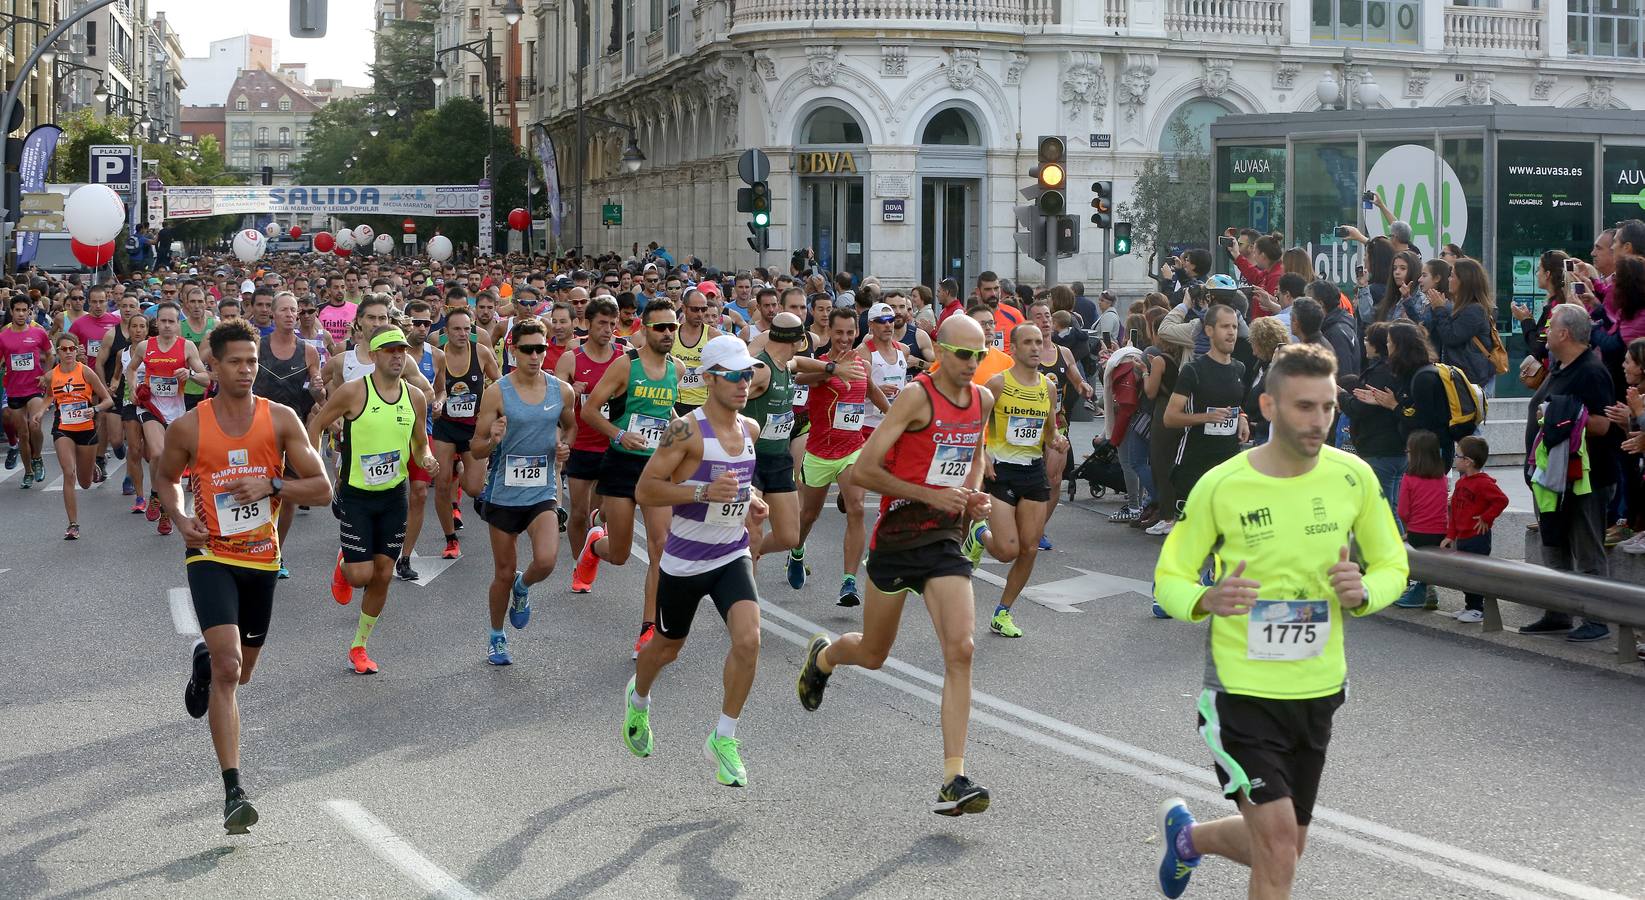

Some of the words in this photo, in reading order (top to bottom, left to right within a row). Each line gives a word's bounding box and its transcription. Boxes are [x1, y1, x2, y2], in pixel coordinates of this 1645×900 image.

[99, 156, 124, 182] P
[797, 151, 858, 174] BBVA
[1233, 159, 1270, 173] AUVASA
[1508, 166, 1583, 176] www.auvasa.es
[169, 194, 212, 209] 2019
[269, 187, 380, 205] SALIDA
[436, 193, 480, 208] 2019
[683, 375, 699, 384] 986
[156, 384, 172, 392] 334
[634, 385, 673, 400] BIKILA
[451, 402, 473, 411] 1740
[67, 410, 82, 418] 152
[843, 414, 860, 424] 640
[774, 424, 792, 434] 1754
[1014, 428, 1038, 439] 1388
[212, 467, 237, 479] CAMPO
[238, 465, 268, 474] GRANDE
[368, 462, 395, 477] 1621
[513, 467, 541, 479] 1128
[940, 462, 967, 476] 1228
[231, 503, 259, 521] 735
[722, 503, 745, 517] 972
[1305, 522, 1339, 535] SEGOVIA
[1263, 624, 1317, 643] 1775
